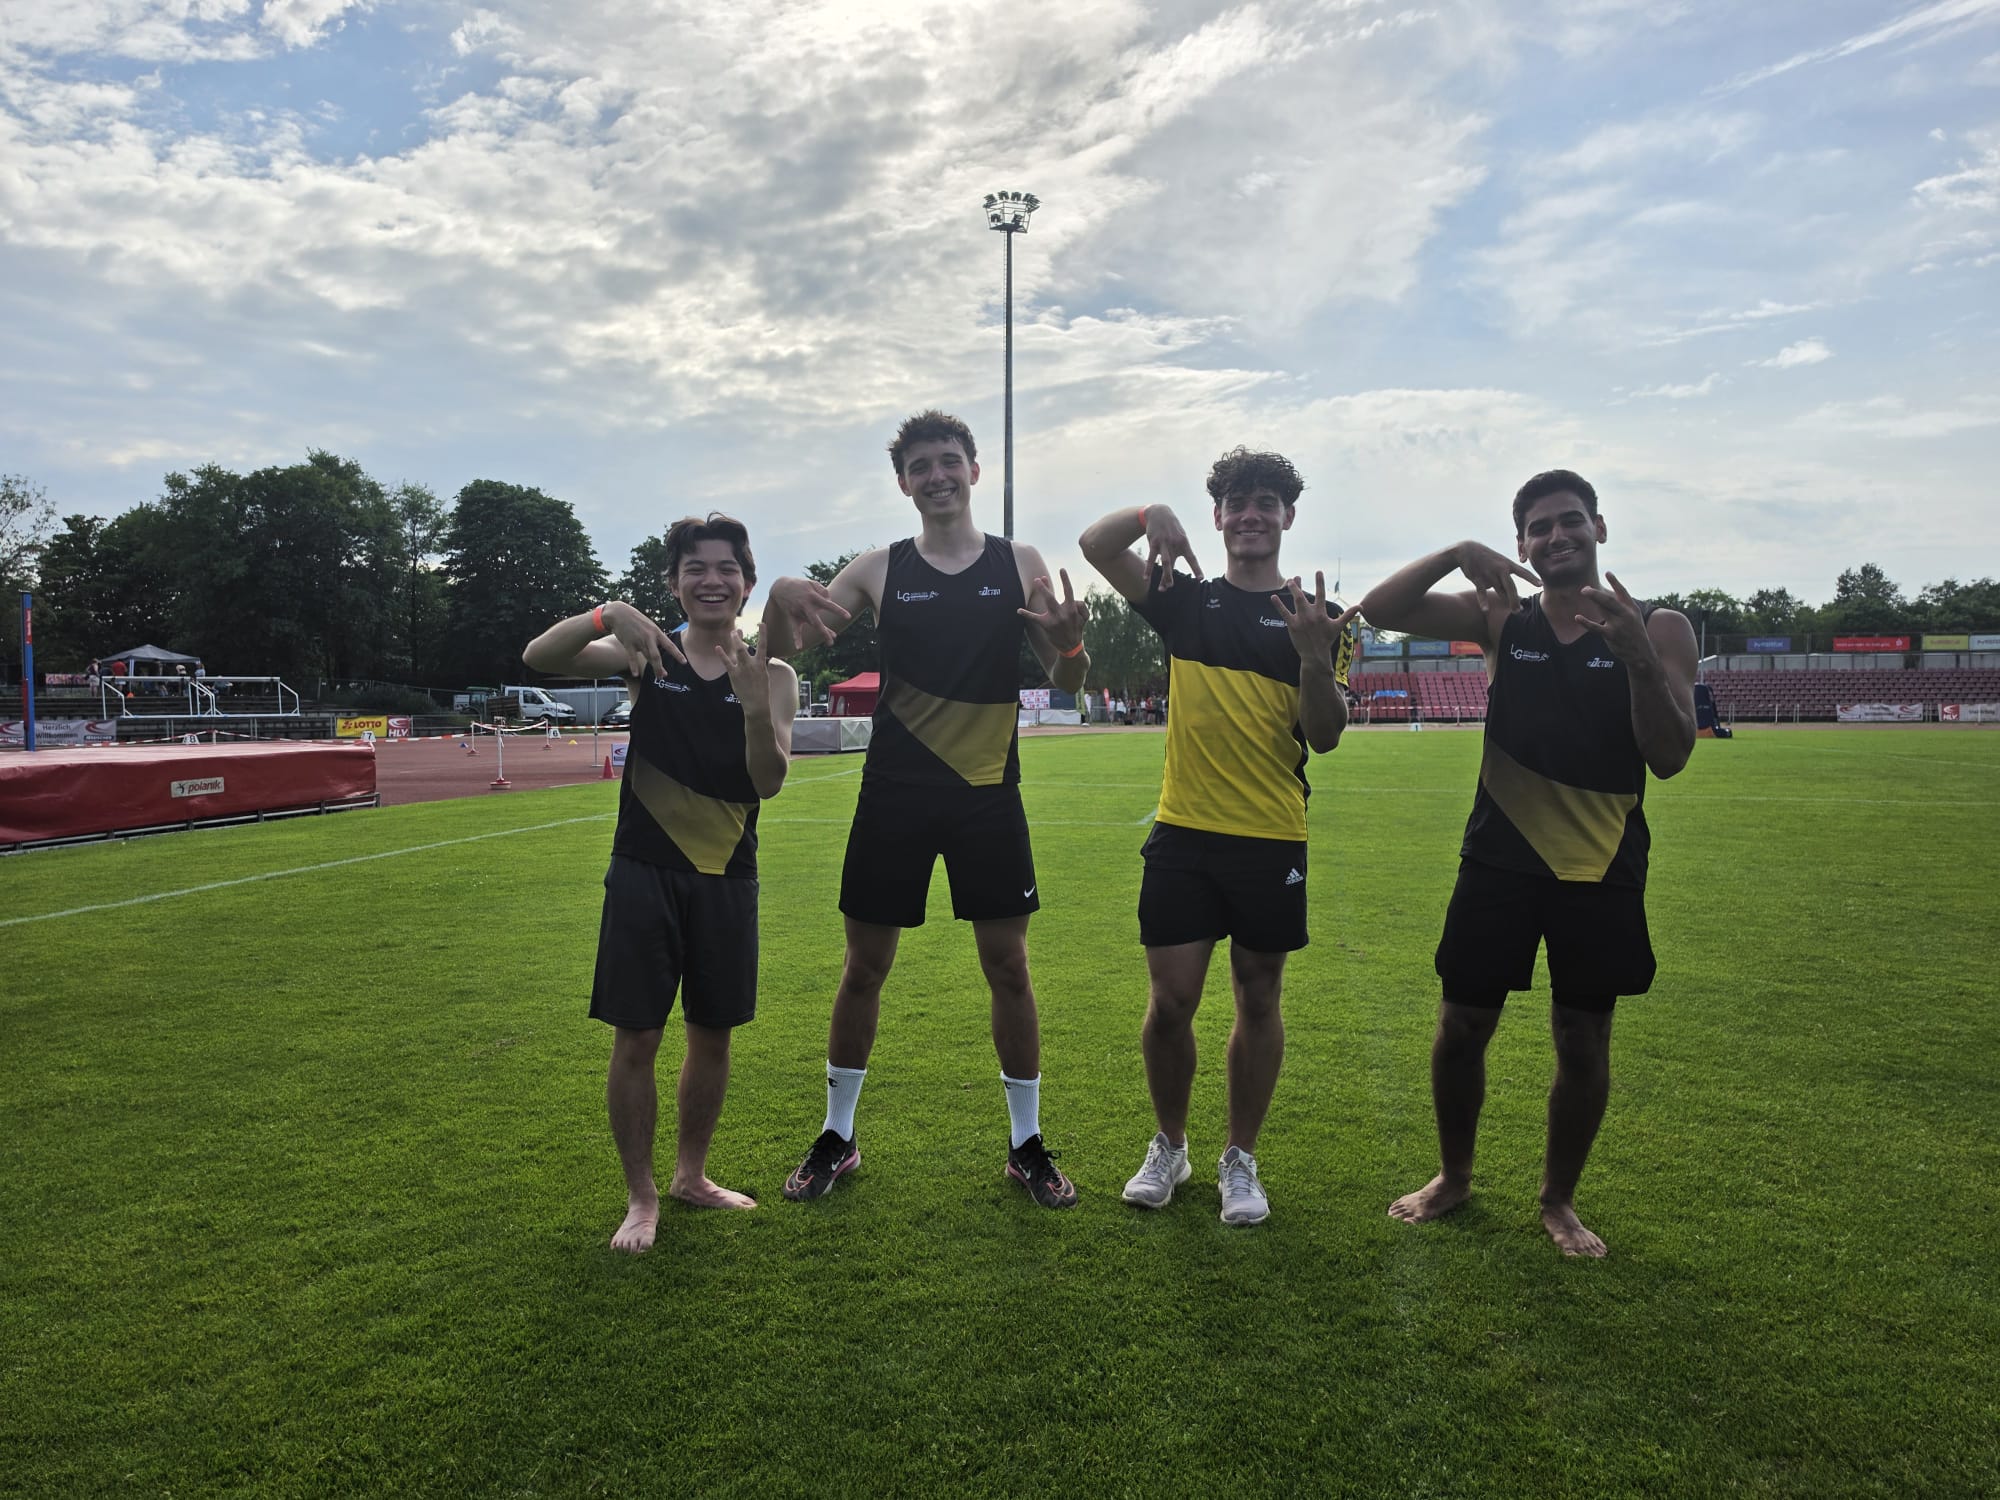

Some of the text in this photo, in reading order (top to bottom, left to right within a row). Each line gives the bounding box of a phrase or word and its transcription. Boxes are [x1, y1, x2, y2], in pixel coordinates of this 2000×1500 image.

[897, 590, 911, 602] LG
[1260, 616, 1271, 627] LG
[1510, 643, 1523, 660] LG
[42, 723, 71, 731] Herzlich
[354, 720, 382, 729] LOTTO
[388, 728, 408, 737] HLV
[187, 780, 223, 794] polanik
